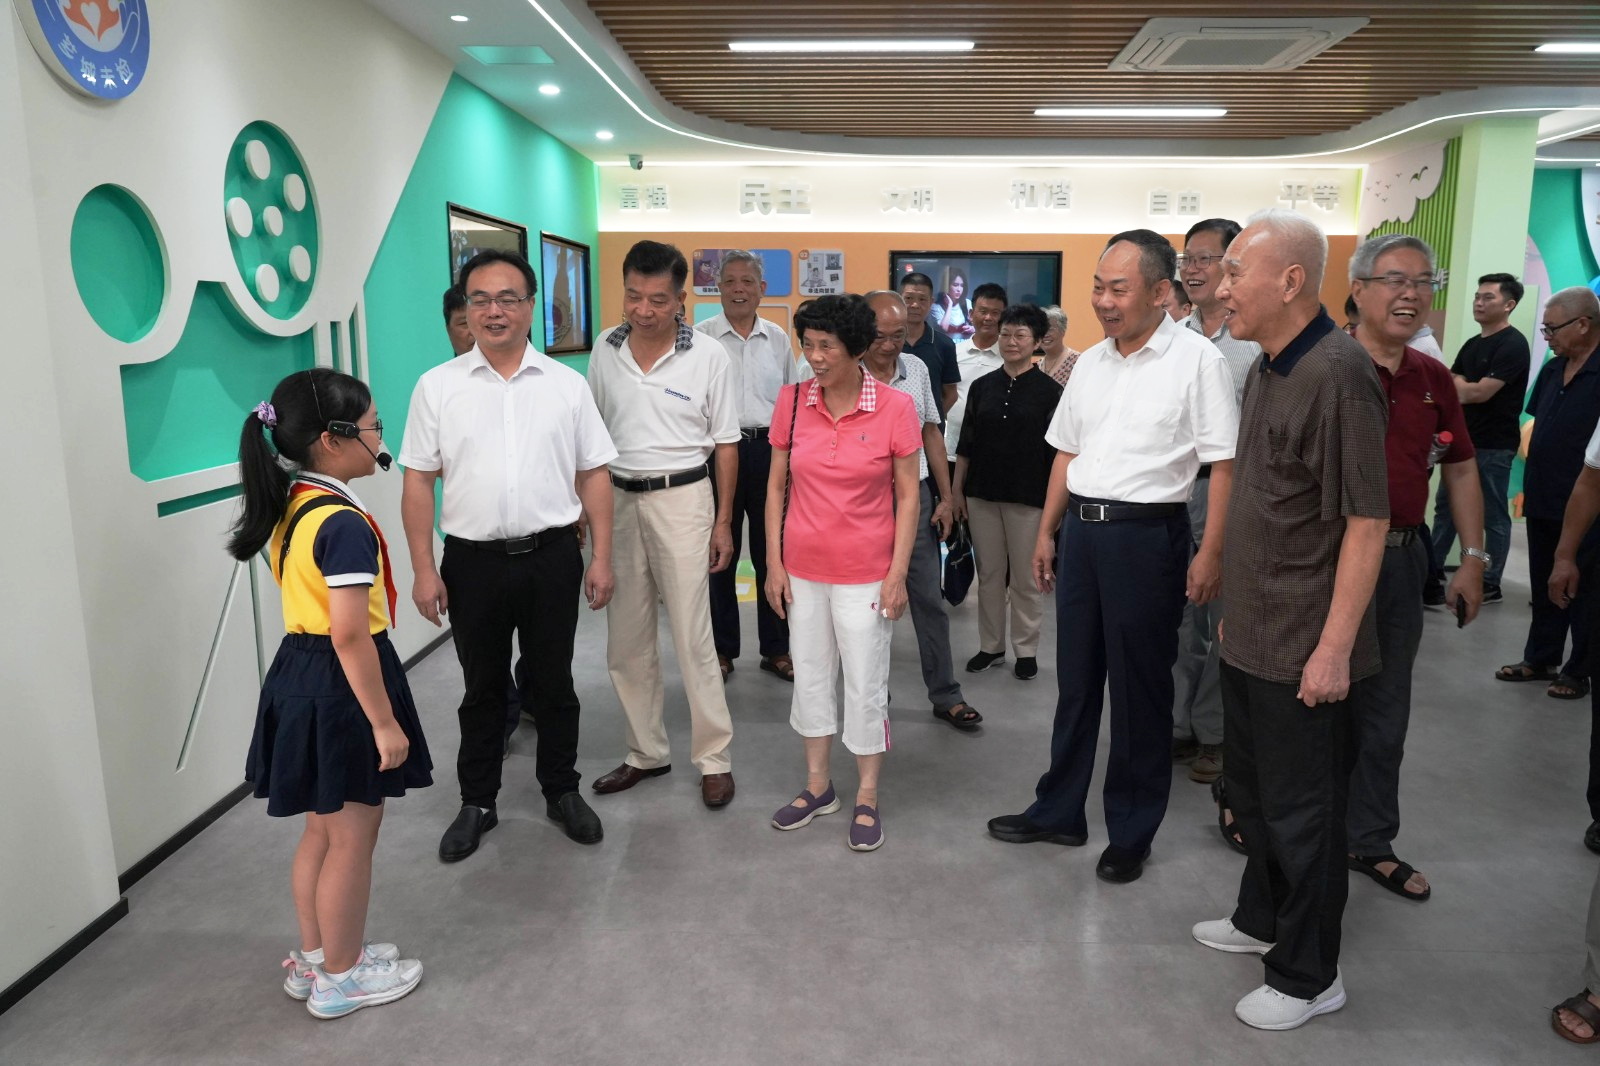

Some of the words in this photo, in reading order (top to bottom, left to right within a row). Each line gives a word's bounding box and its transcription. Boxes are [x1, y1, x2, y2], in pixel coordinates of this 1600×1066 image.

[619, 184, 669, 210] 富强
[739, 178, 812, 215] 民主
[881, 186, 935, 213] 文明
[1009, 179, 1072, 210] 和谐
[1149, 188, 1201, 216] 自由
[1279, 180, 1340, 211] 平等
